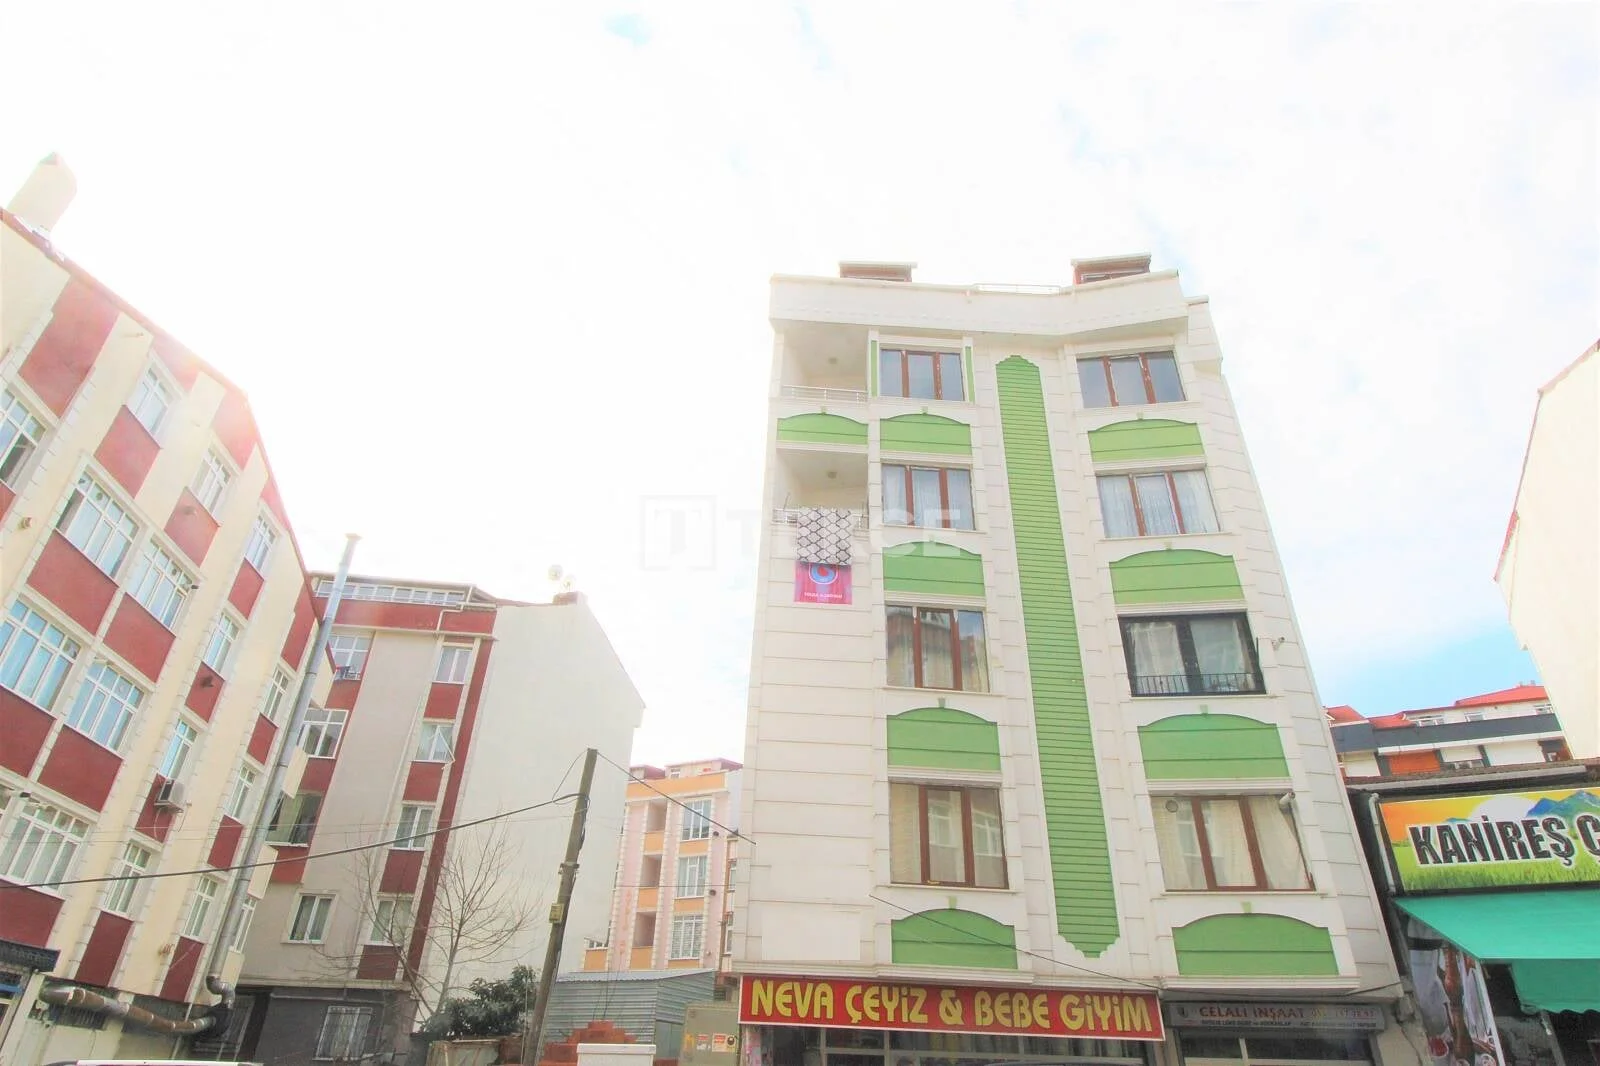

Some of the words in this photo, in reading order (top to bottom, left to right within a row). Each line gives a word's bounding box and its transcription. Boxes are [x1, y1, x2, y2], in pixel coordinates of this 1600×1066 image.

[1409, 815, 1575, 866] KANİREŞ
[751, 979, 834, 1020] NEVA
[845, 985, 928, 1024] ÇEYİZ
[939, 989, 964, 1026] &
[975, 990, 1050, 1029] BEBE
[1059, 994, 1153, 1032] GİYİM
